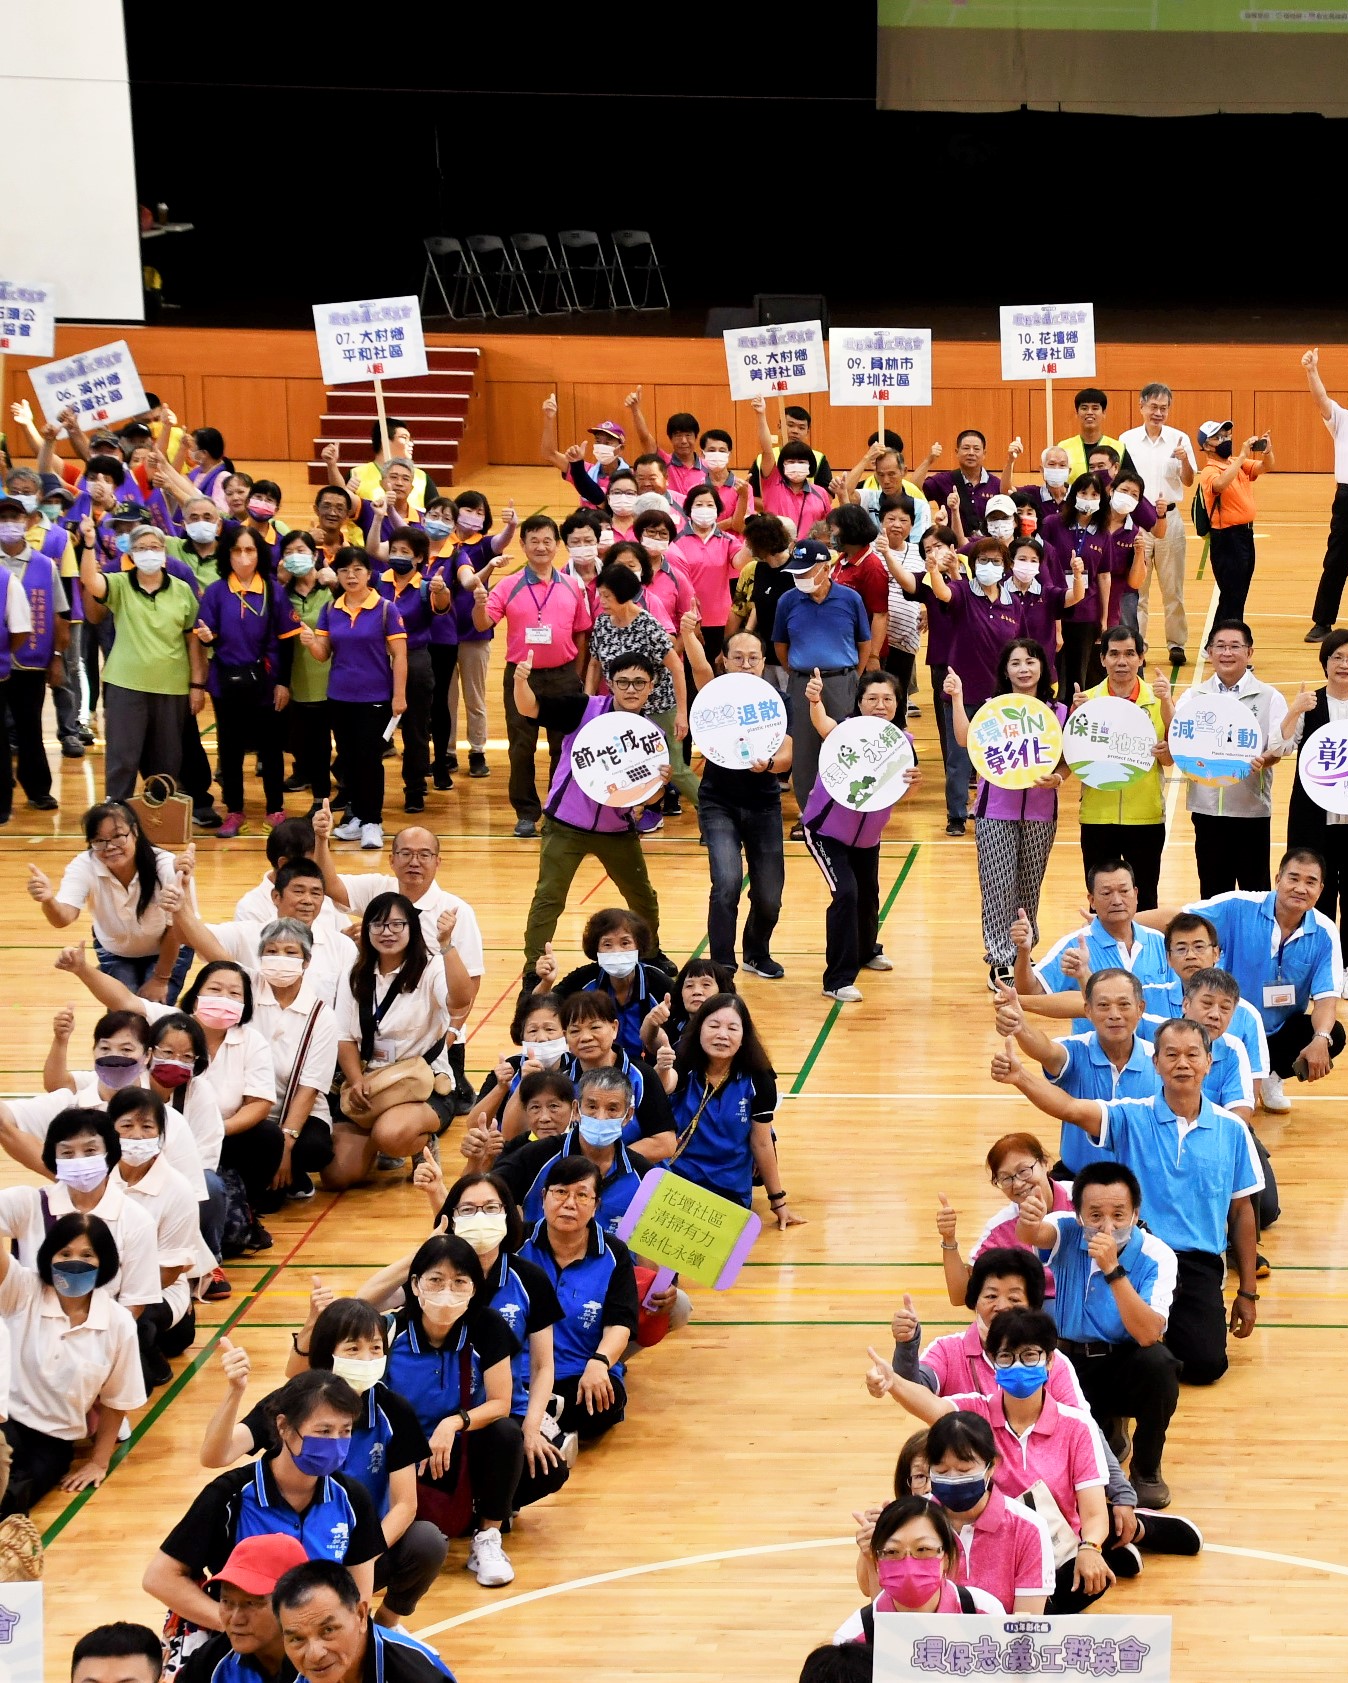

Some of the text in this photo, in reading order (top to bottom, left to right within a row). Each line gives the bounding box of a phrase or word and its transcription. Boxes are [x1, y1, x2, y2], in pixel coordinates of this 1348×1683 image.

[336, 327, 404, 345] 07. 大村鄉
[1018, 330, 1078, 344] 10. 花壇鄉
[343, 344, 403, 362] 平和社區
[744, 348, 808, 366] 08. 大村鄉
[1022, 346, 1075, 361] 永春社區
[750, 363, 806, 380] 美港社區
[847, 356, 914, 370] 09. 員林市
[852, 373, 910, 386] 浮圳社區
[56, 389, 75, 401] 06.
[572, 729, 662, 770] 節能減碳
[984, 736, 1053, 775] 彰化
[1107, 754, 1126, 763] protect
[1136, 758, 1151, 767] Earth
[662, 1187, 727, 1229] 花壇社區
[651, 1207, 715, 1248] 清掃有力
[639, 1228, 706, 1270] 綠化永續
